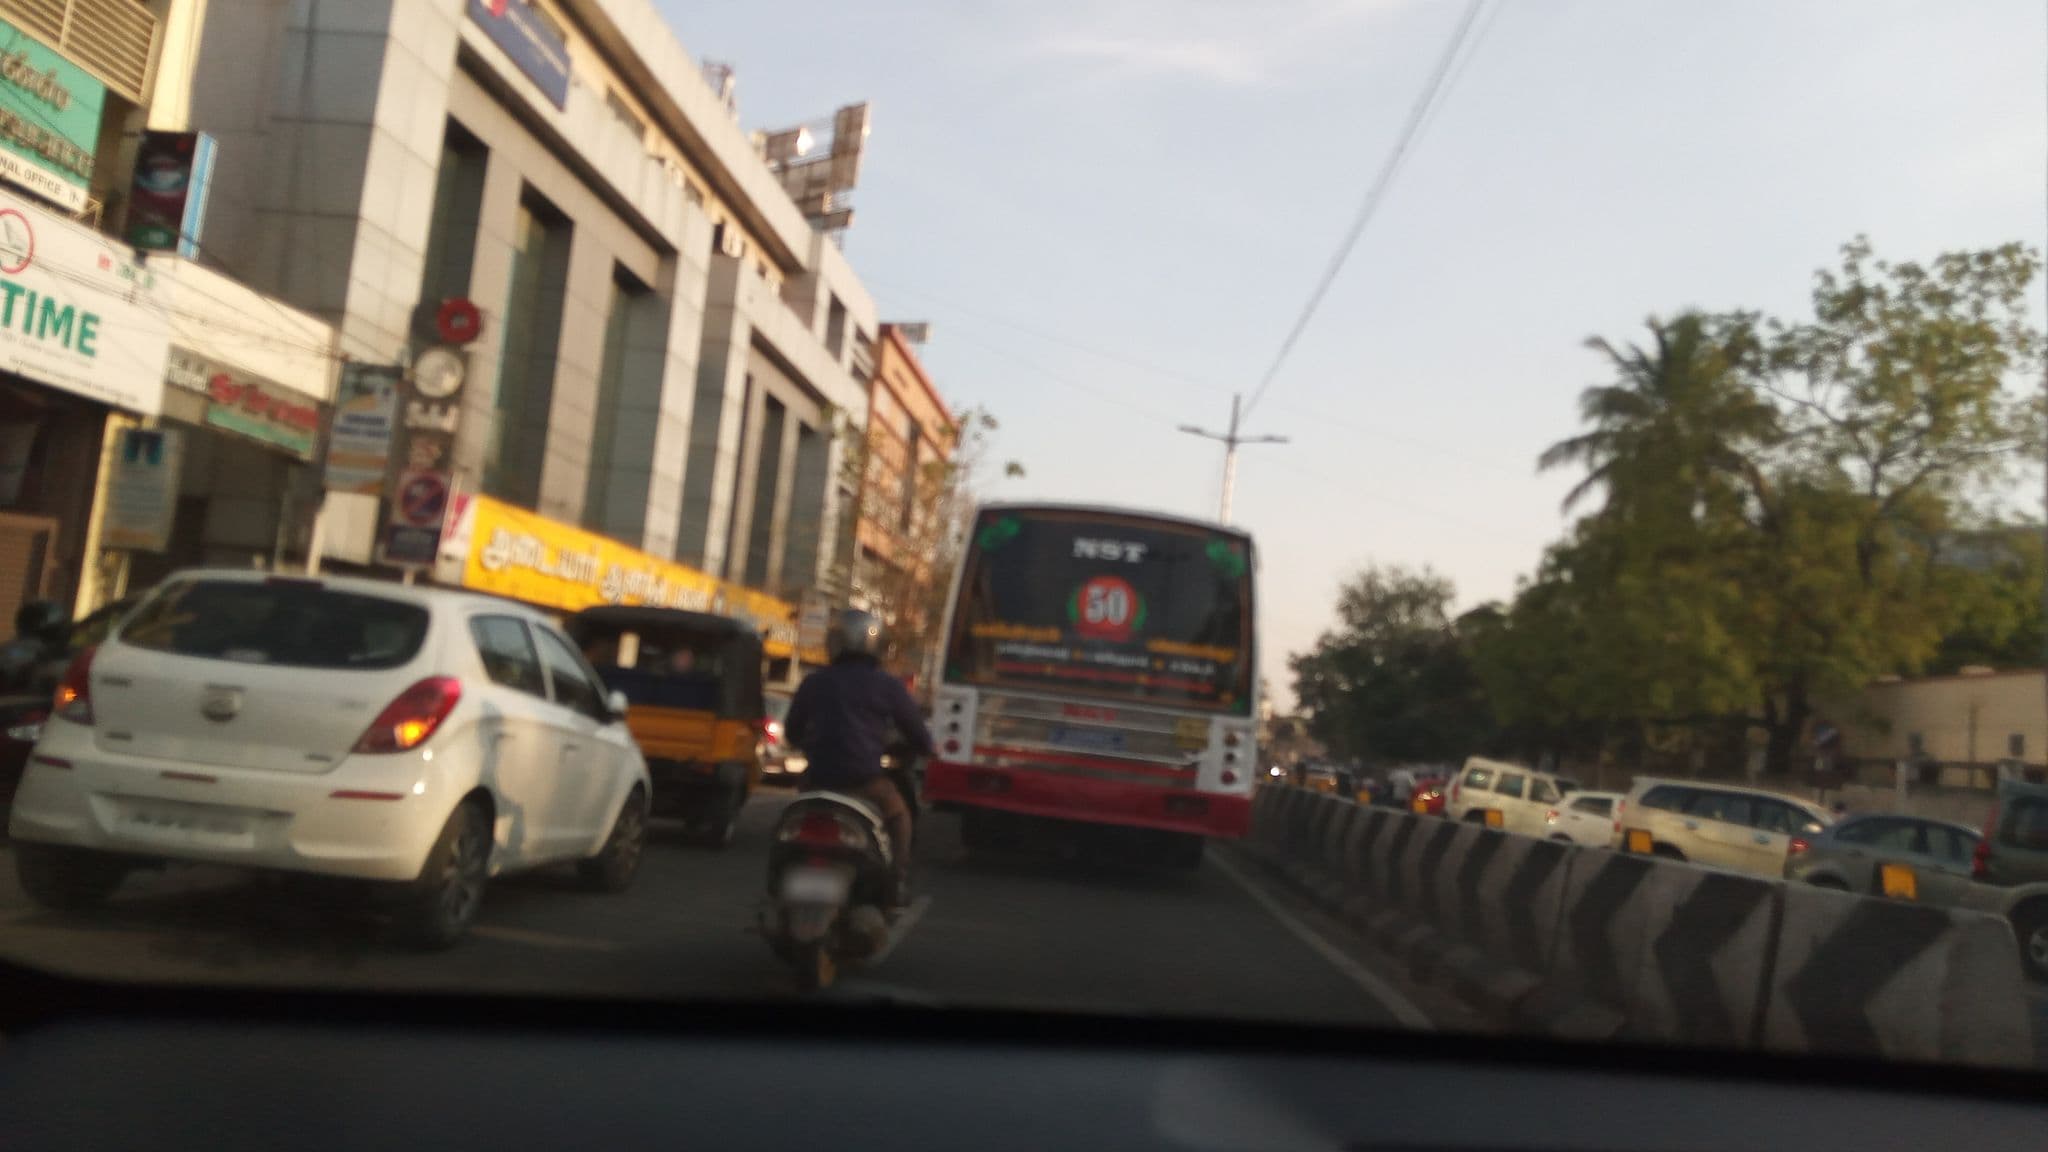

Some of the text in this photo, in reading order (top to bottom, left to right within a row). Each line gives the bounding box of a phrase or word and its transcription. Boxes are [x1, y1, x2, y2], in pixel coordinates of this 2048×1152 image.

[24, 168, 61, 194] OFFICE
[0, 279, 100, 356] TIME
[1073, 537, 1148, 563] NST
[1085, 584, 1129, 626] 50
